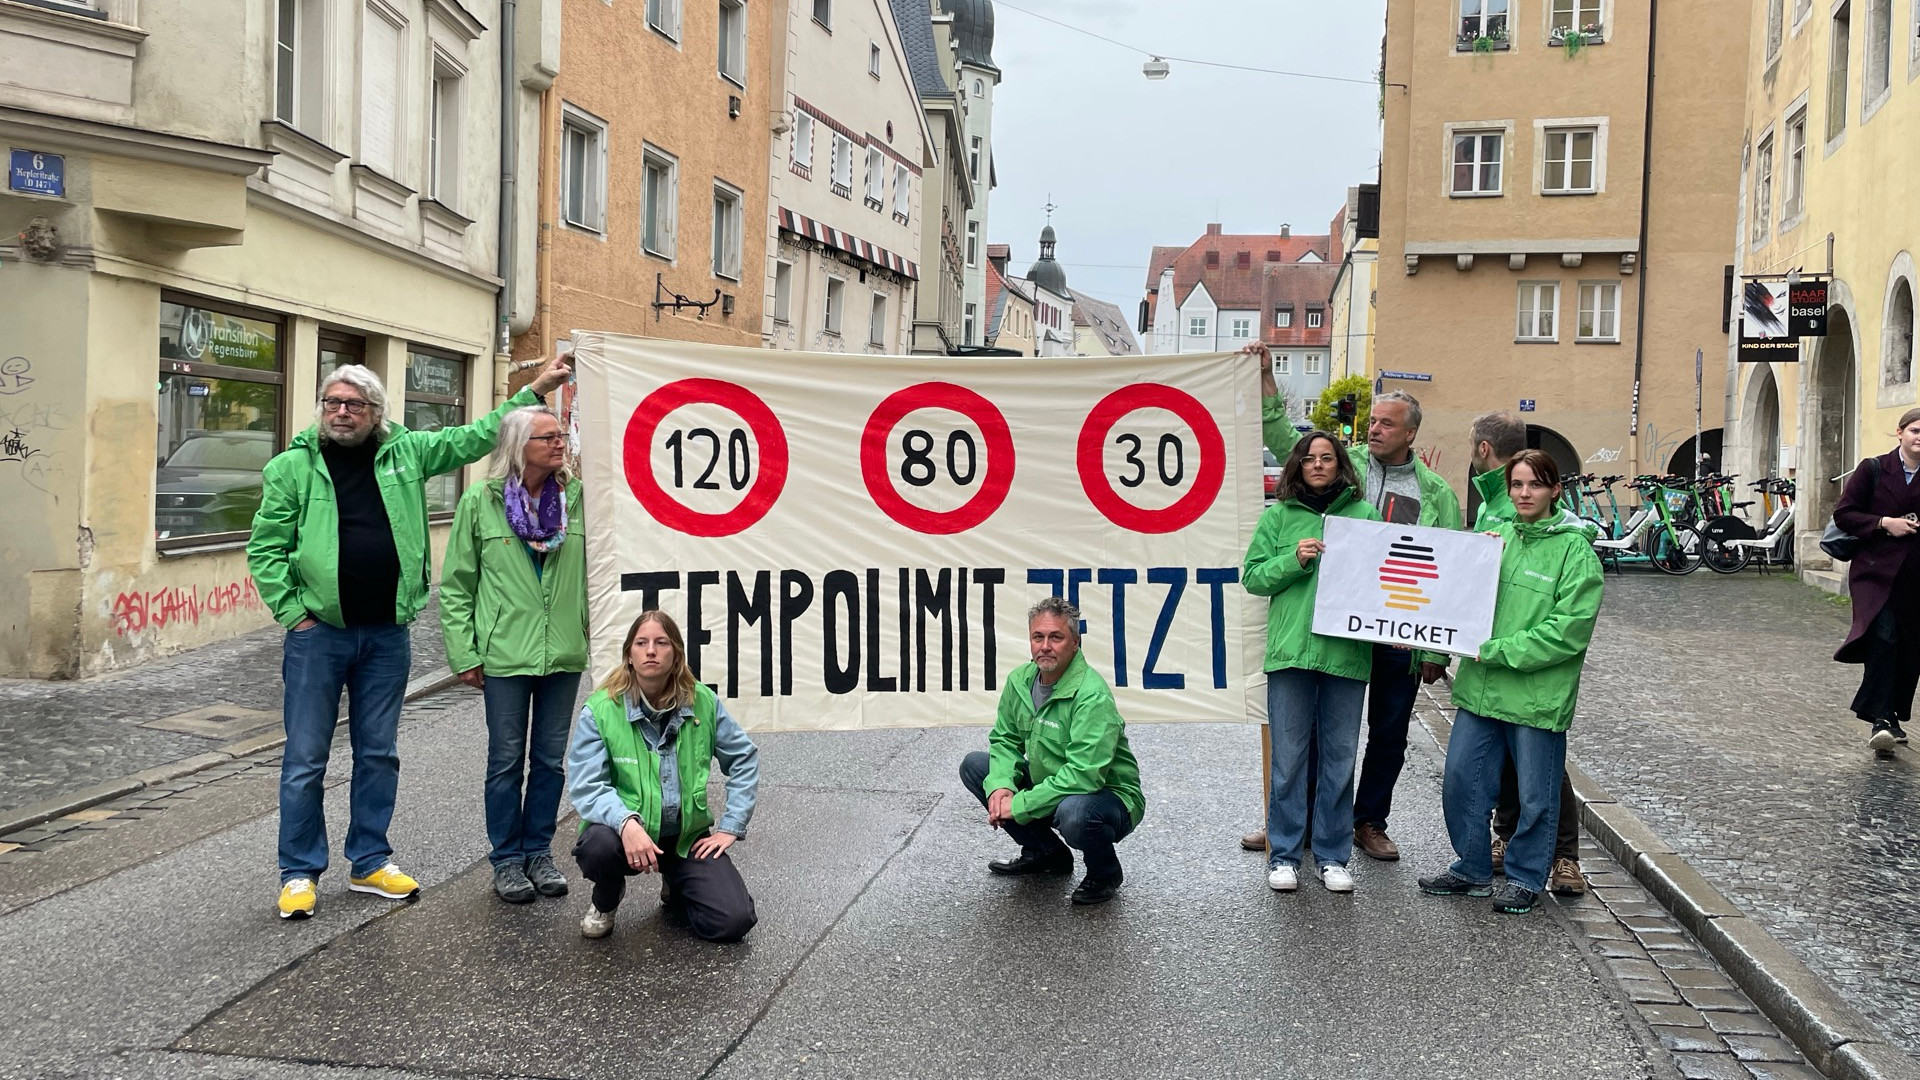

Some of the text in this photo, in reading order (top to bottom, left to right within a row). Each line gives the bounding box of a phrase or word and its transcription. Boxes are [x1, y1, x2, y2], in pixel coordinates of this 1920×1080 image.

[33, 154, 45, 171] 6
[35, 180, 52, 189] 147)
[1791, 290, 1825, 298] HAAR
[1791, 306, 1825, 317] basel
[665, 428, 751, 491] 120
[900, 429, 977, 487] 80
[1115, 432, 1184, 488] 30
[621, 567, 1006, 699] TEMPOLIMIT
[1347, 615, 1458, 646] D-TICKET
